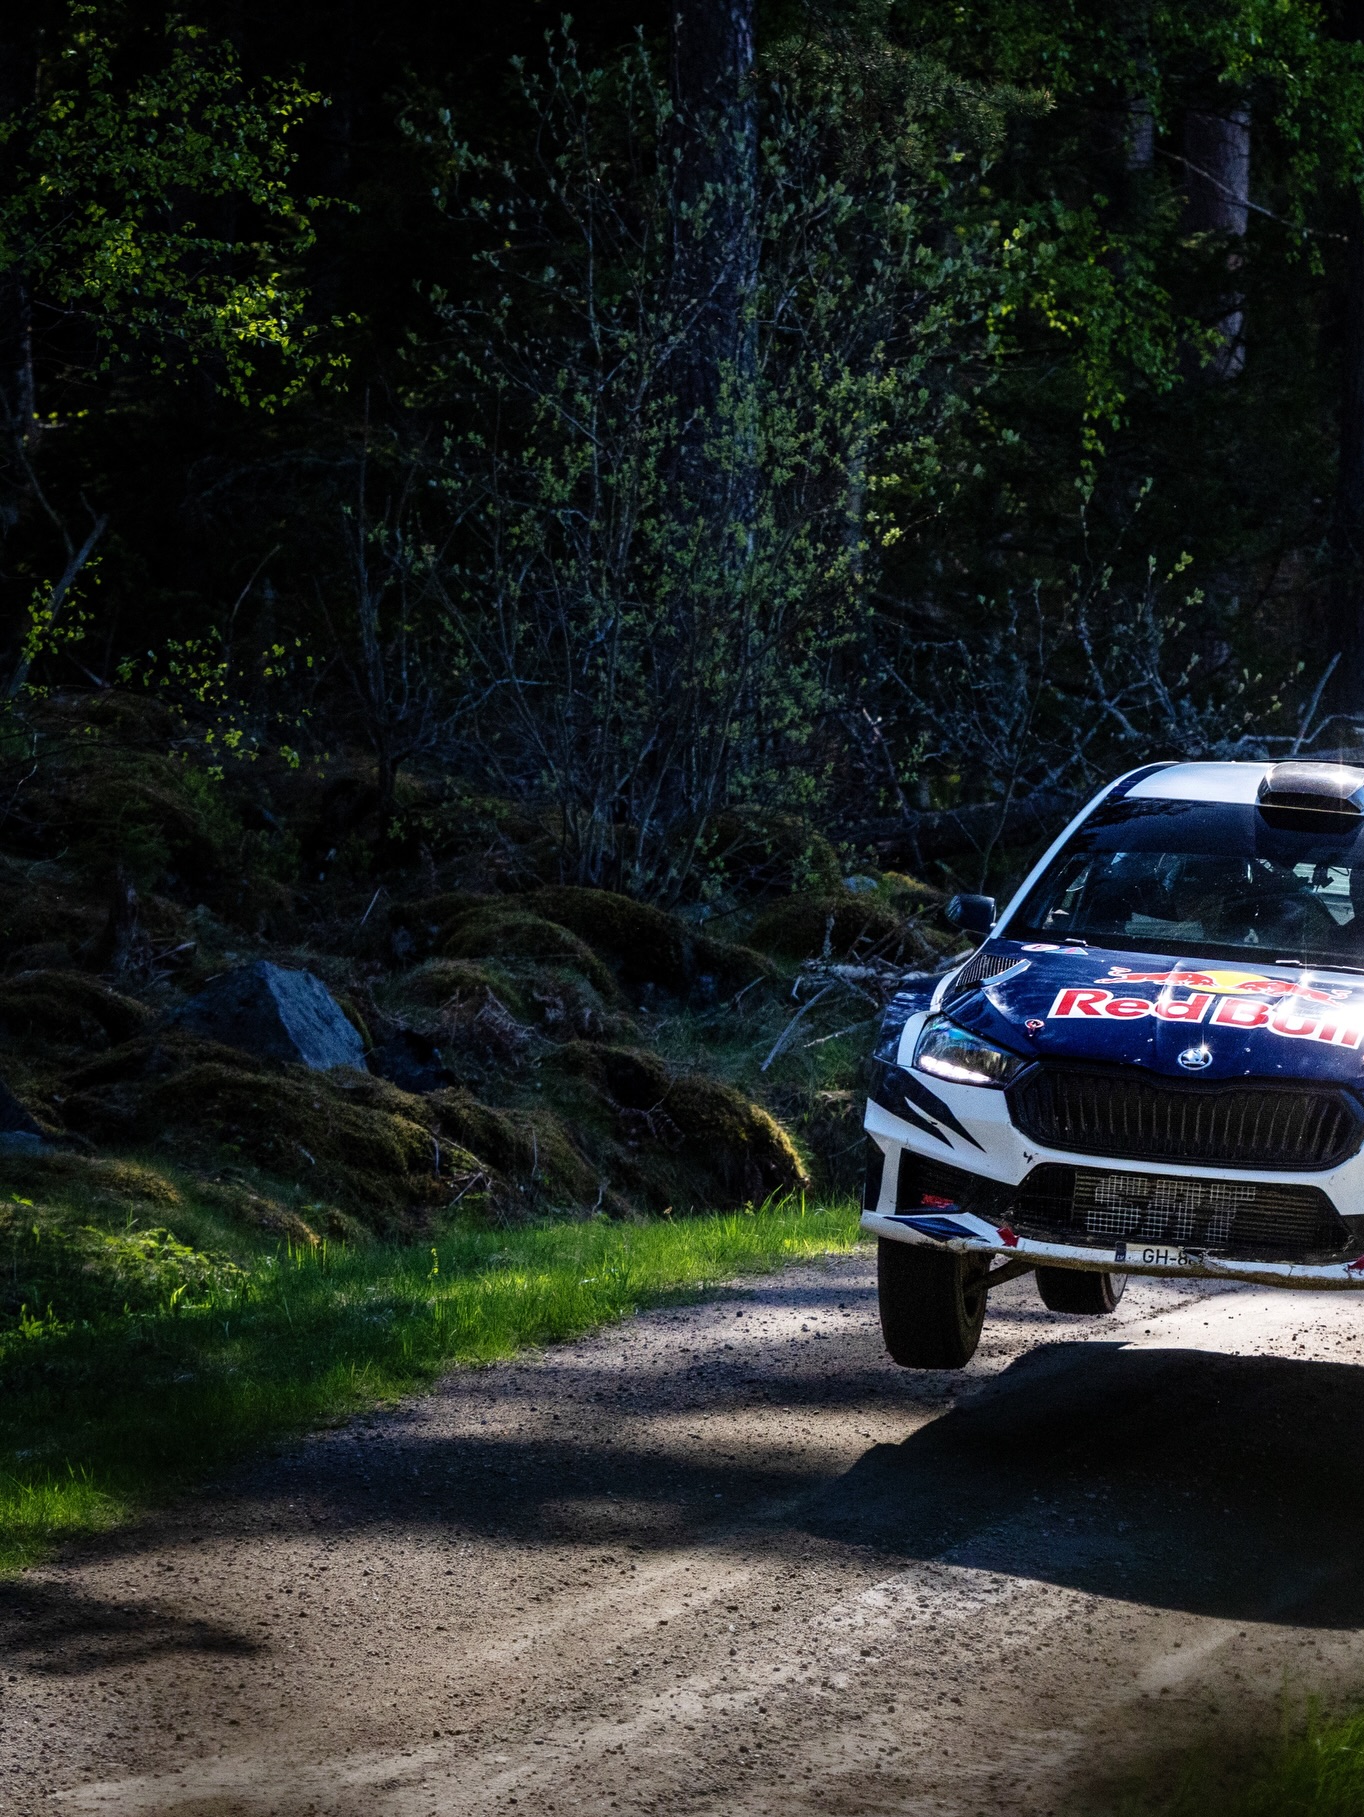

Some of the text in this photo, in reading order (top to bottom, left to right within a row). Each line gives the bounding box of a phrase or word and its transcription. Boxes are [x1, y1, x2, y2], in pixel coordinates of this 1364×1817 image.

[1051, 989, 1361, 1047] Red Bull
[1143, 1248, 1204, 1265] GH-8
